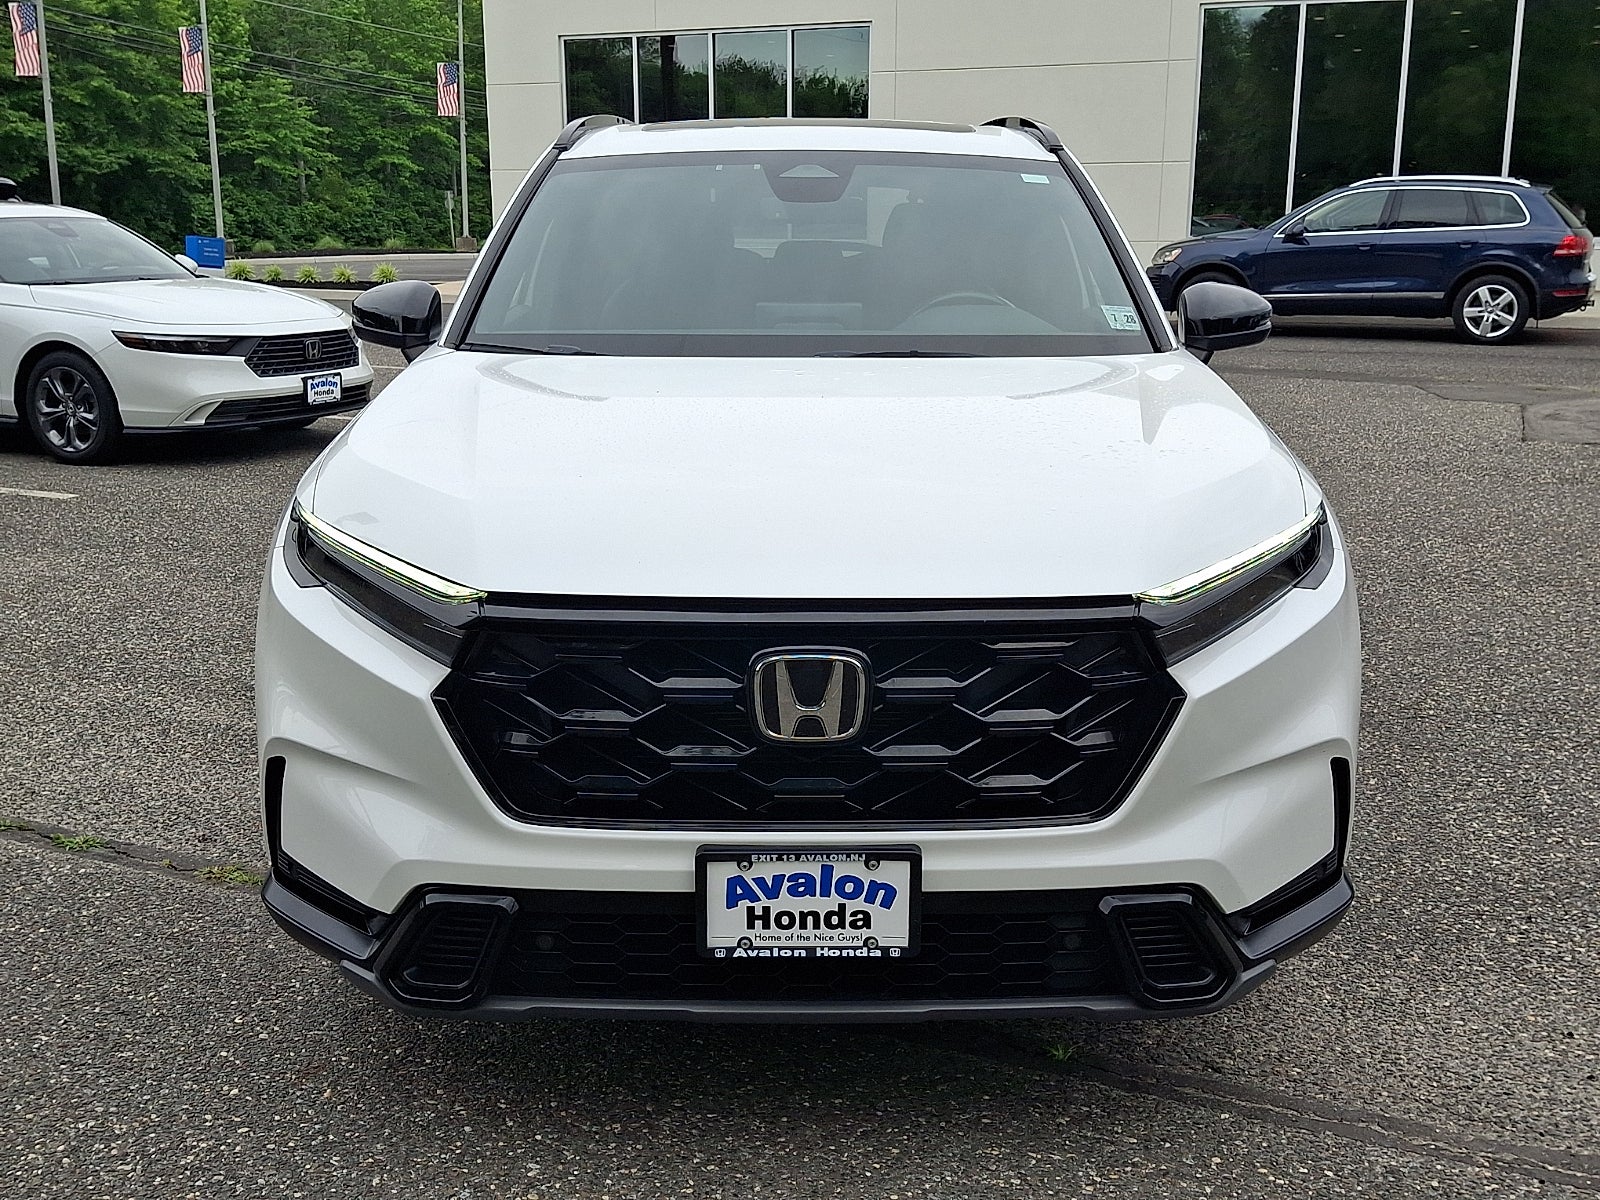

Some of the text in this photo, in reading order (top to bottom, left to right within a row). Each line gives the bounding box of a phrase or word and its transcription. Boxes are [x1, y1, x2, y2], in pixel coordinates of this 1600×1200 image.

[1123, 314, 1137, 324] 28
[310, 378, 338, 391] Avalon
[313, 388, 335, 397] Honda
[751, 854, 778, 862] EXIT
[782, 854, 796, 862] 13
[726, 863, 898, 910] Avalon
[746, 903, 872, 931] Honda
[754, 933, 863, 944] Home of the Nice Guys!
[732, 947, 882, 958] Avalon Honda
